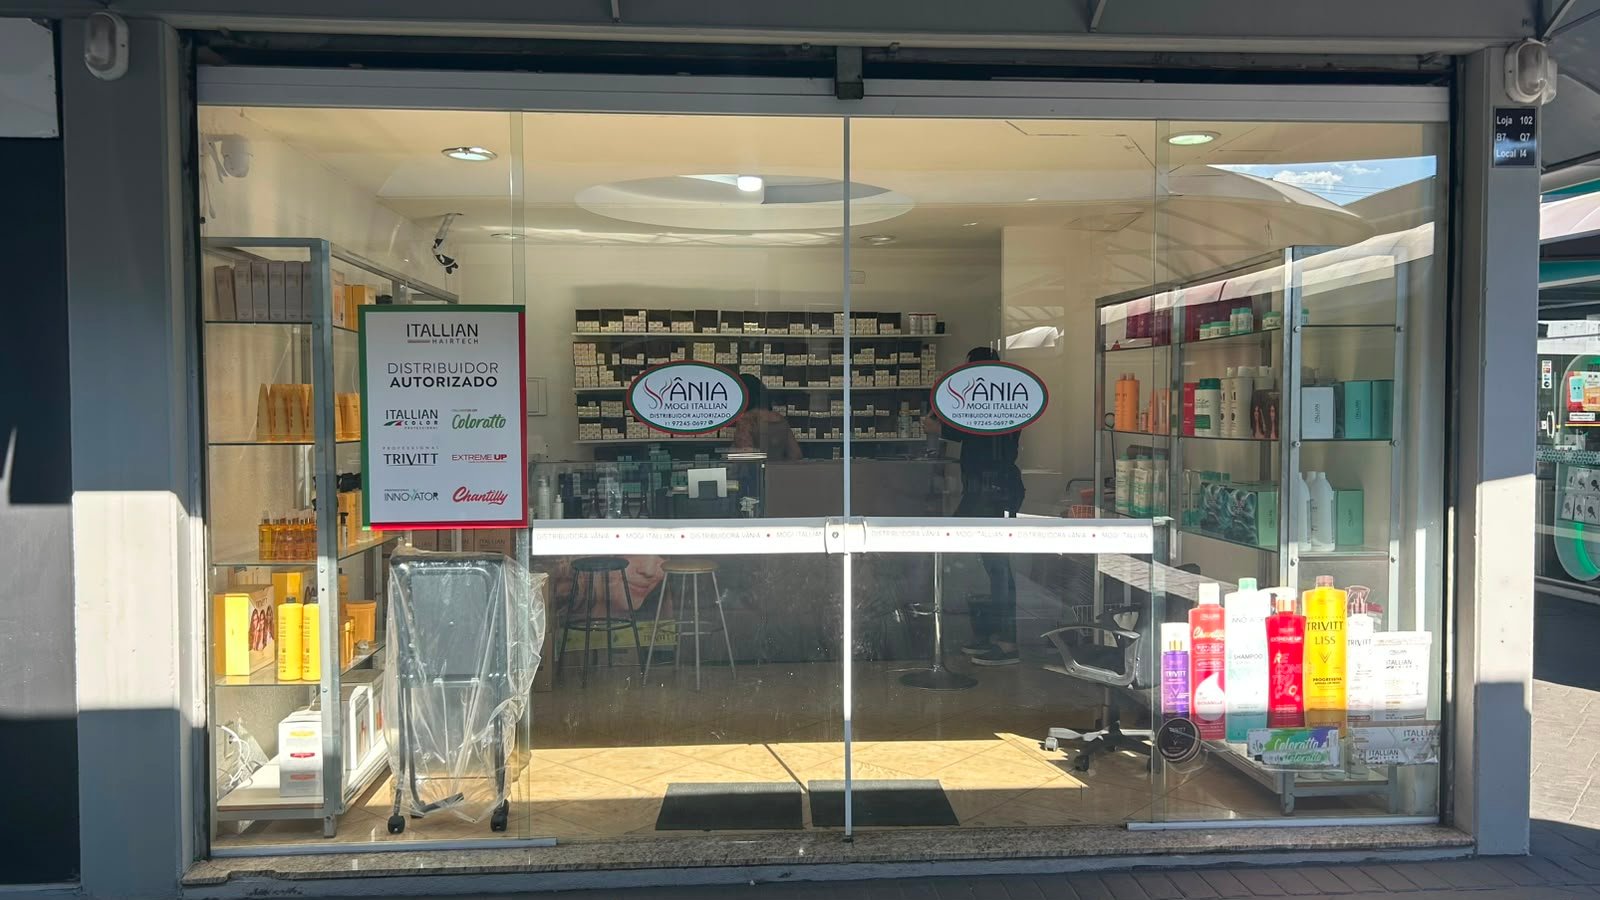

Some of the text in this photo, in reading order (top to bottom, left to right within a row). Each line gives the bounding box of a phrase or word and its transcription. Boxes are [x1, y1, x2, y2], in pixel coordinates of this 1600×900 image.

[1496, 116, 1532, 126] Loja 102
[1496, 133, 1530, 141] B7 Q7
[1496, 149, 1516, 158] Local
[406, 323, 478, 338] ITALLIAN
[387, 362, 498, 374] DISTRIBUIDOR
[389, 376, 498, 388] AUTORIZADO
[664, 402, 728, 410] MOGI ITALLIAN
[966, 402, 1028, 410] MOGI ITALLIAN
[385, 409, 438, 420] ITALLIAN
[452, 413, 507, 430] Coloratto
[383, 453, 439, 466] TRIVITT
[452, 486, 508, 505] Chantilly
[1306, 621, 1344, 632] TRIVITT
[1314, 636, 1336, 645] LISS
[1348, 639, 1372, 647] TRIVITT
[1274, 737, 1319, 752] Coloratto
[1368, 749, 1399, 757] ITALLIAN
